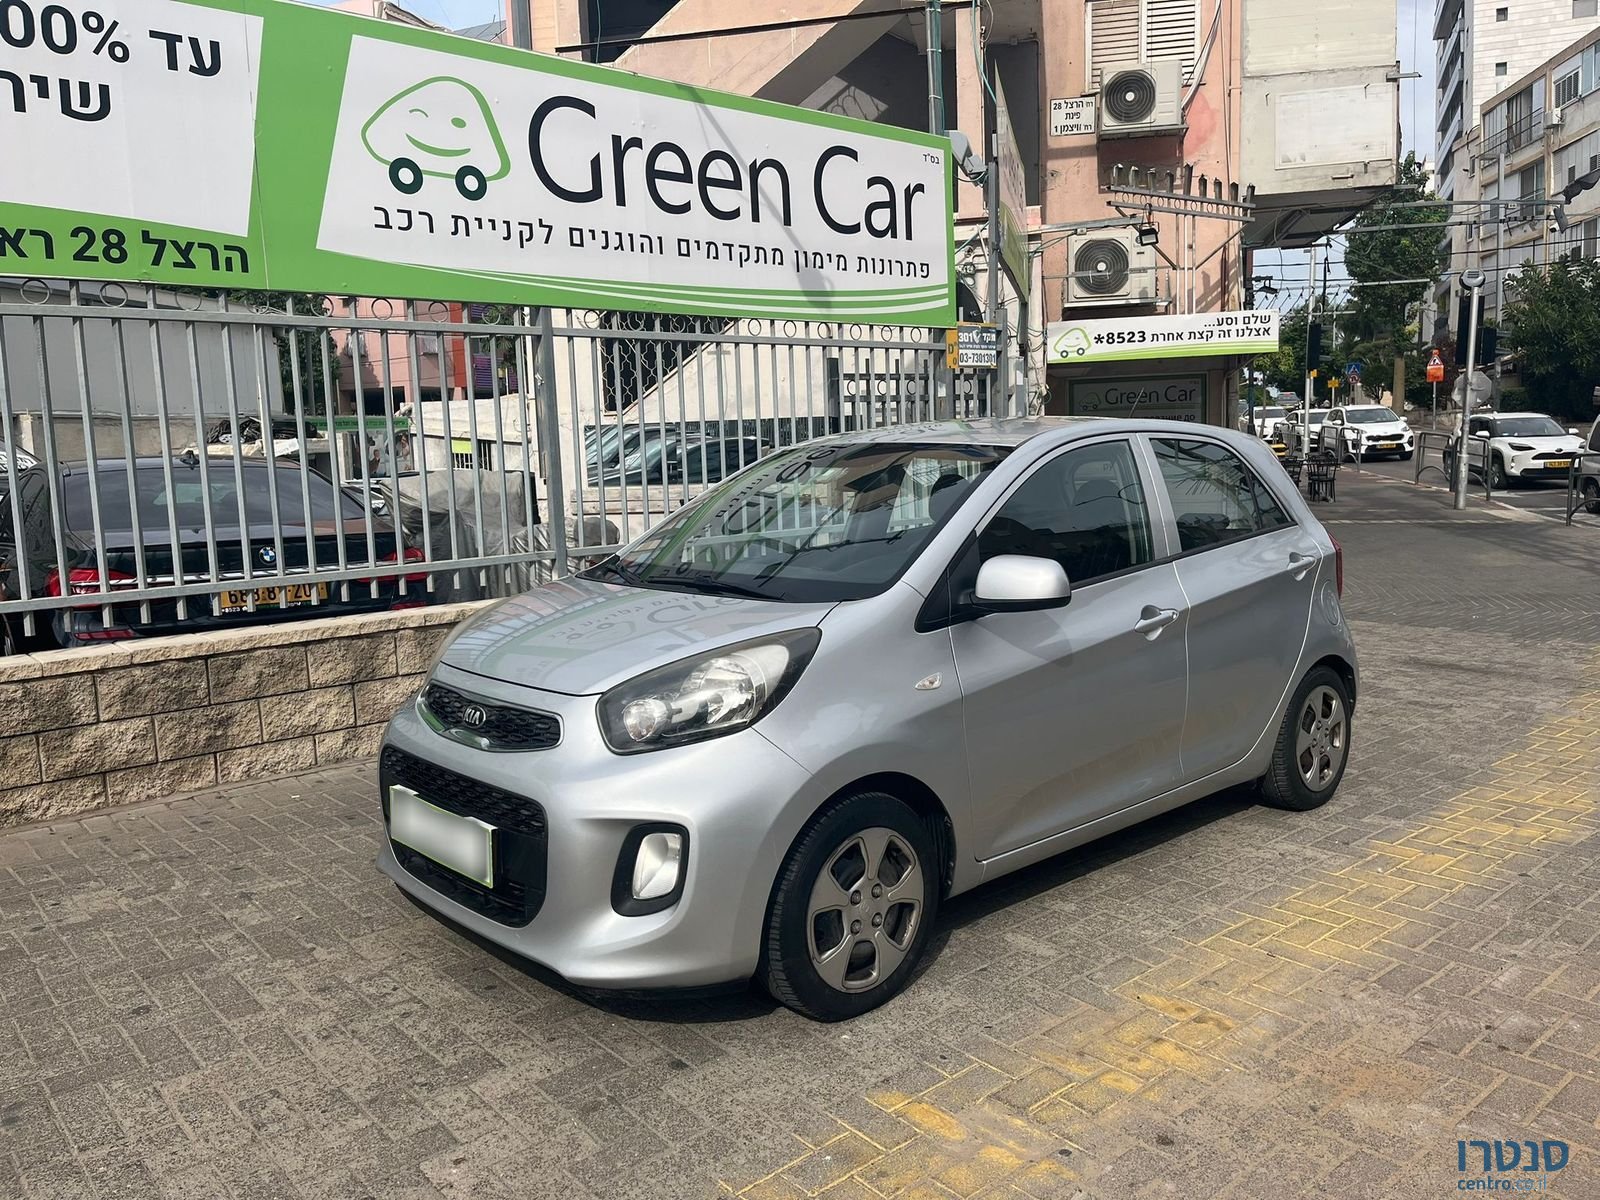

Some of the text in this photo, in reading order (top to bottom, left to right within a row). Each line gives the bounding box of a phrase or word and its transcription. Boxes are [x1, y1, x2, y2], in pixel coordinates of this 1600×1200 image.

[149, 30, 221, 76] עד
[1053, 102, 1062, 110] 28
[1064, 100, 1084, 109] הרצל
[1065, 112, 1081, 120] פינת
[529, 96, 791, 226] Green
[814, 146, 924, 240] Car
[70, 227, 128, 263] 28
[374, 207, 930, 279] פתרונות מימון מתקדמים והוגנים לקניית רכב
[141, 230, 250, 273] הרצל
[1243, 314, 1271, 325] שלם
[958, 332, 973, 343] 301
[1150, 331, 1184, 342] אחרת
[1188, 330, 1214, 341] קצת
[1218, 329, 1232, 338] זה
[1236, 326, 1271, 338] אצלנו
[1105, 385, 1197, 405] Green Car
[464, 707, 481, 725] KIA
